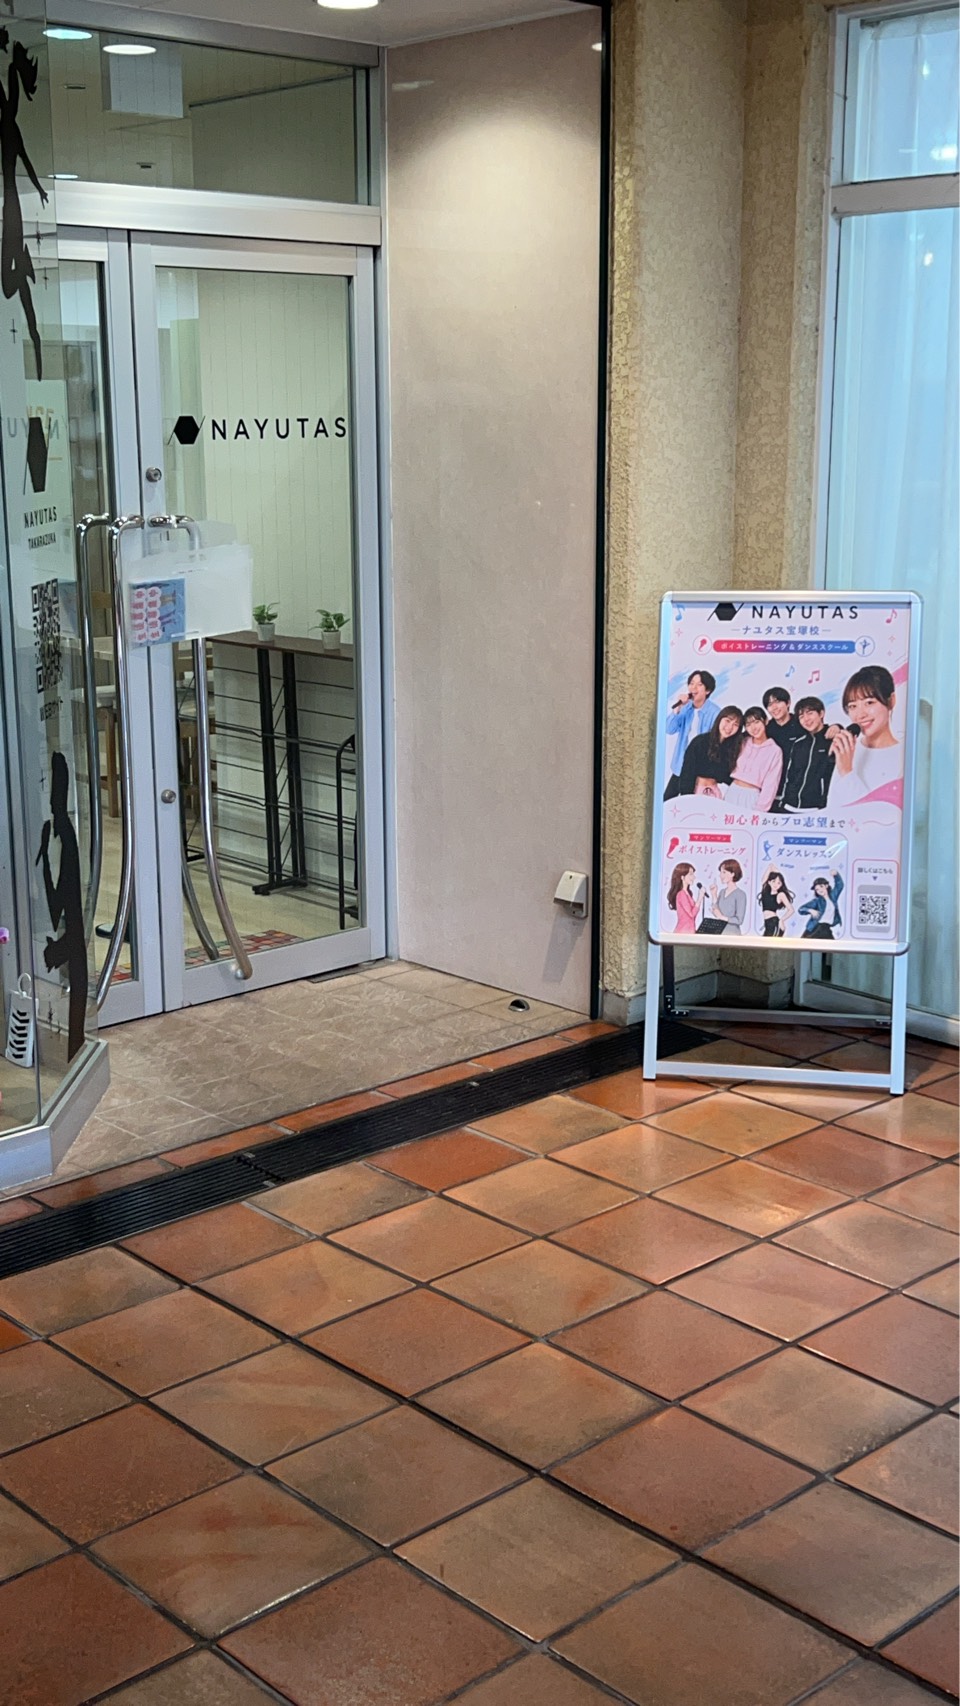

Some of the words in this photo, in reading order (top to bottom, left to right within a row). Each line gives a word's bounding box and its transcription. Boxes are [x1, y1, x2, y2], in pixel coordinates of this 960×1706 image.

[211, 416, 347, 440] NAYUTAS
[23, 506, 58, 529] NAYUTAS
[27, 532, 57, 550] TAKARAZUKA
[752, 605, 859, 620] NAYUTAS
[724, 814, 846, 828] 初心者からプロ志望まで
[678, 845, 747, 856] ボイストレーニング
